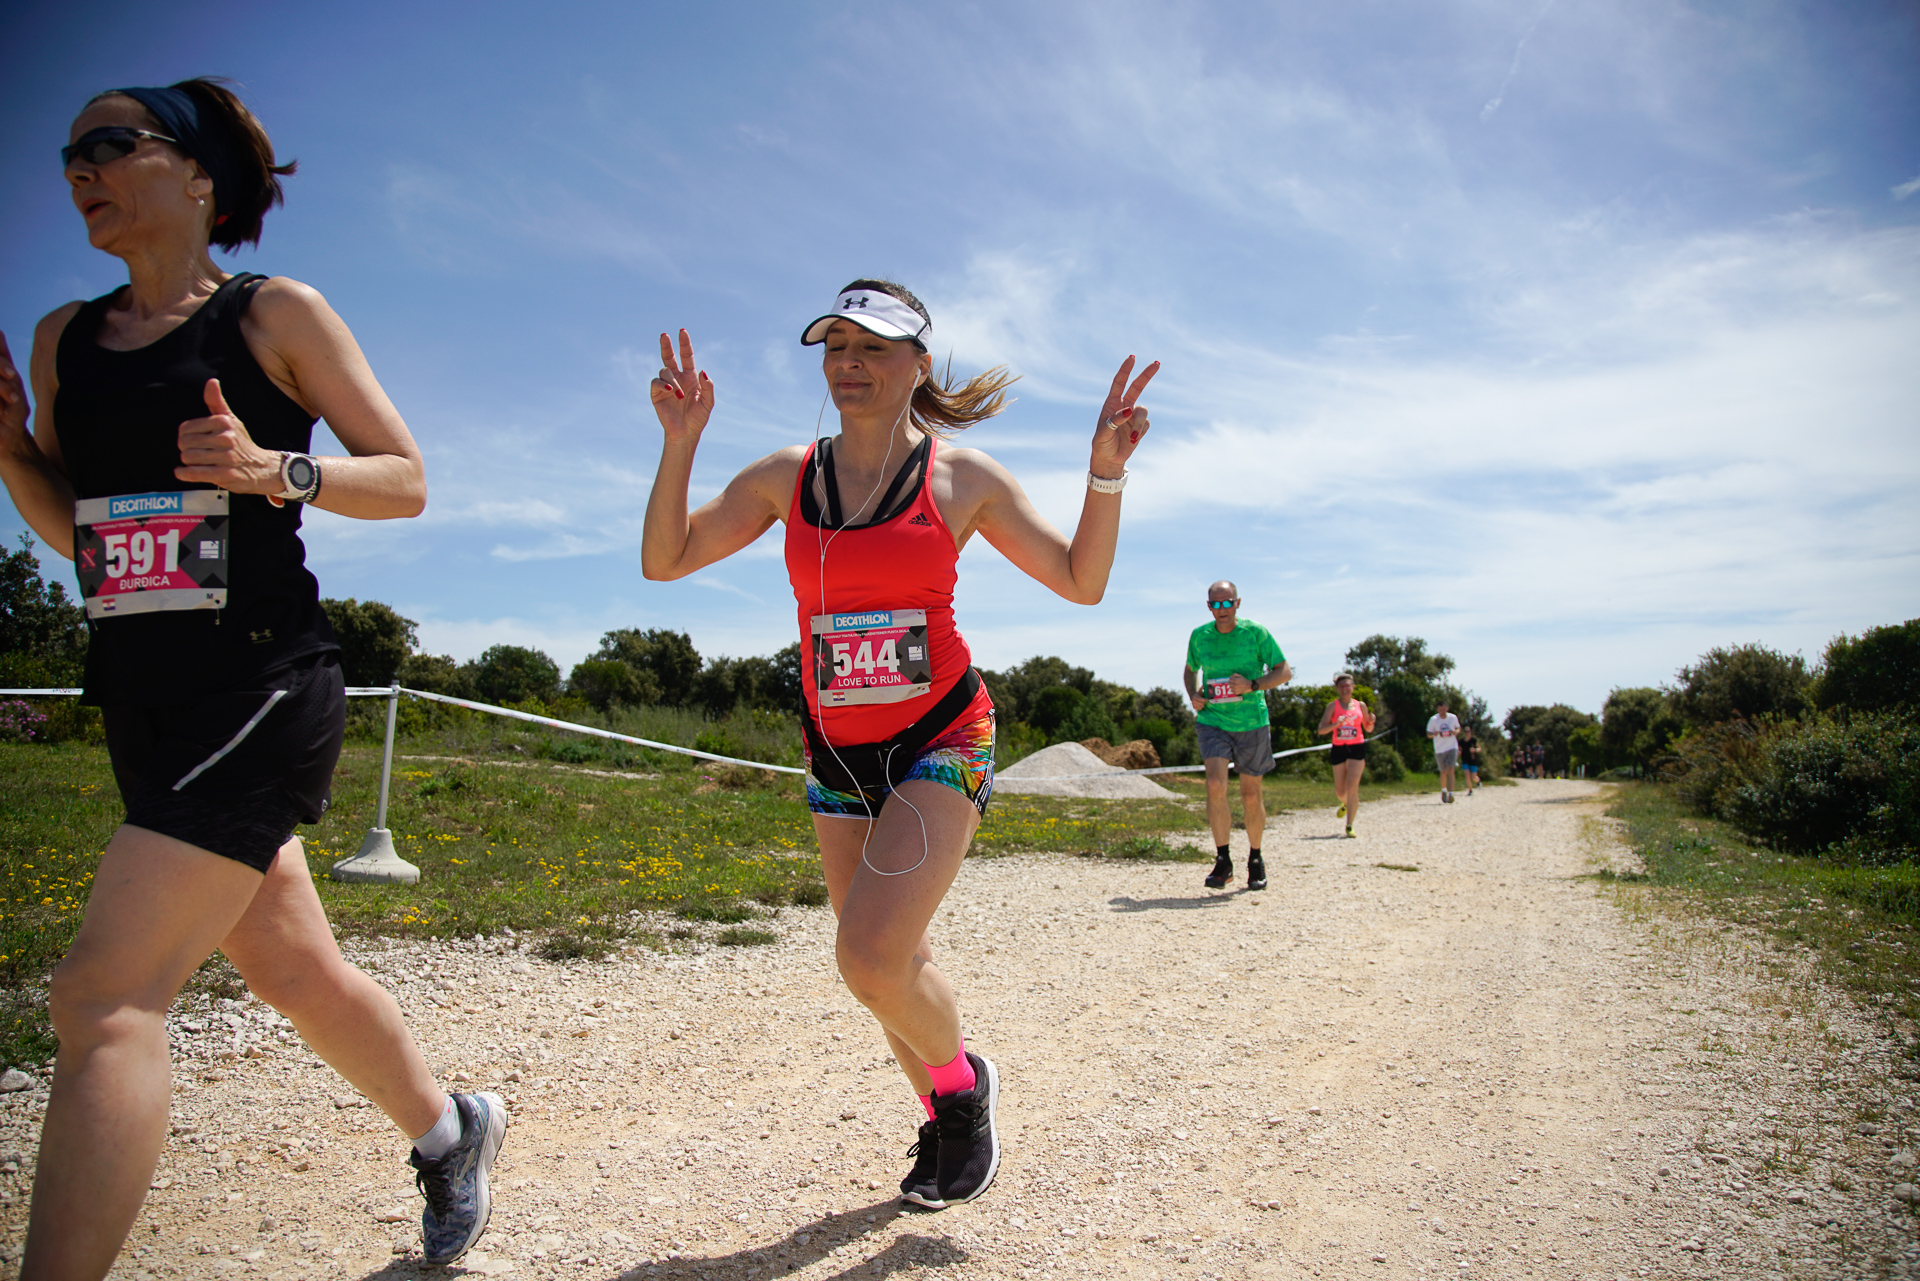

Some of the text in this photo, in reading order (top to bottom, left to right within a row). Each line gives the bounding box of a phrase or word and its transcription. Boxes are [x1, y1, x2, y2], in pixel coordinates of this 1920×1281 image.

[112, 496, 178, 514] DECATHLON
[105, 528, 180, 579] 591
[119, 575, 171, 590] ĐURĐICA
[206, 592, 214, 600] M
[835, 613, 889, 627] DECATHLON
[832, 638, 900, 677] 544
[838, 674, 901, 687] LOVE TO RUN
